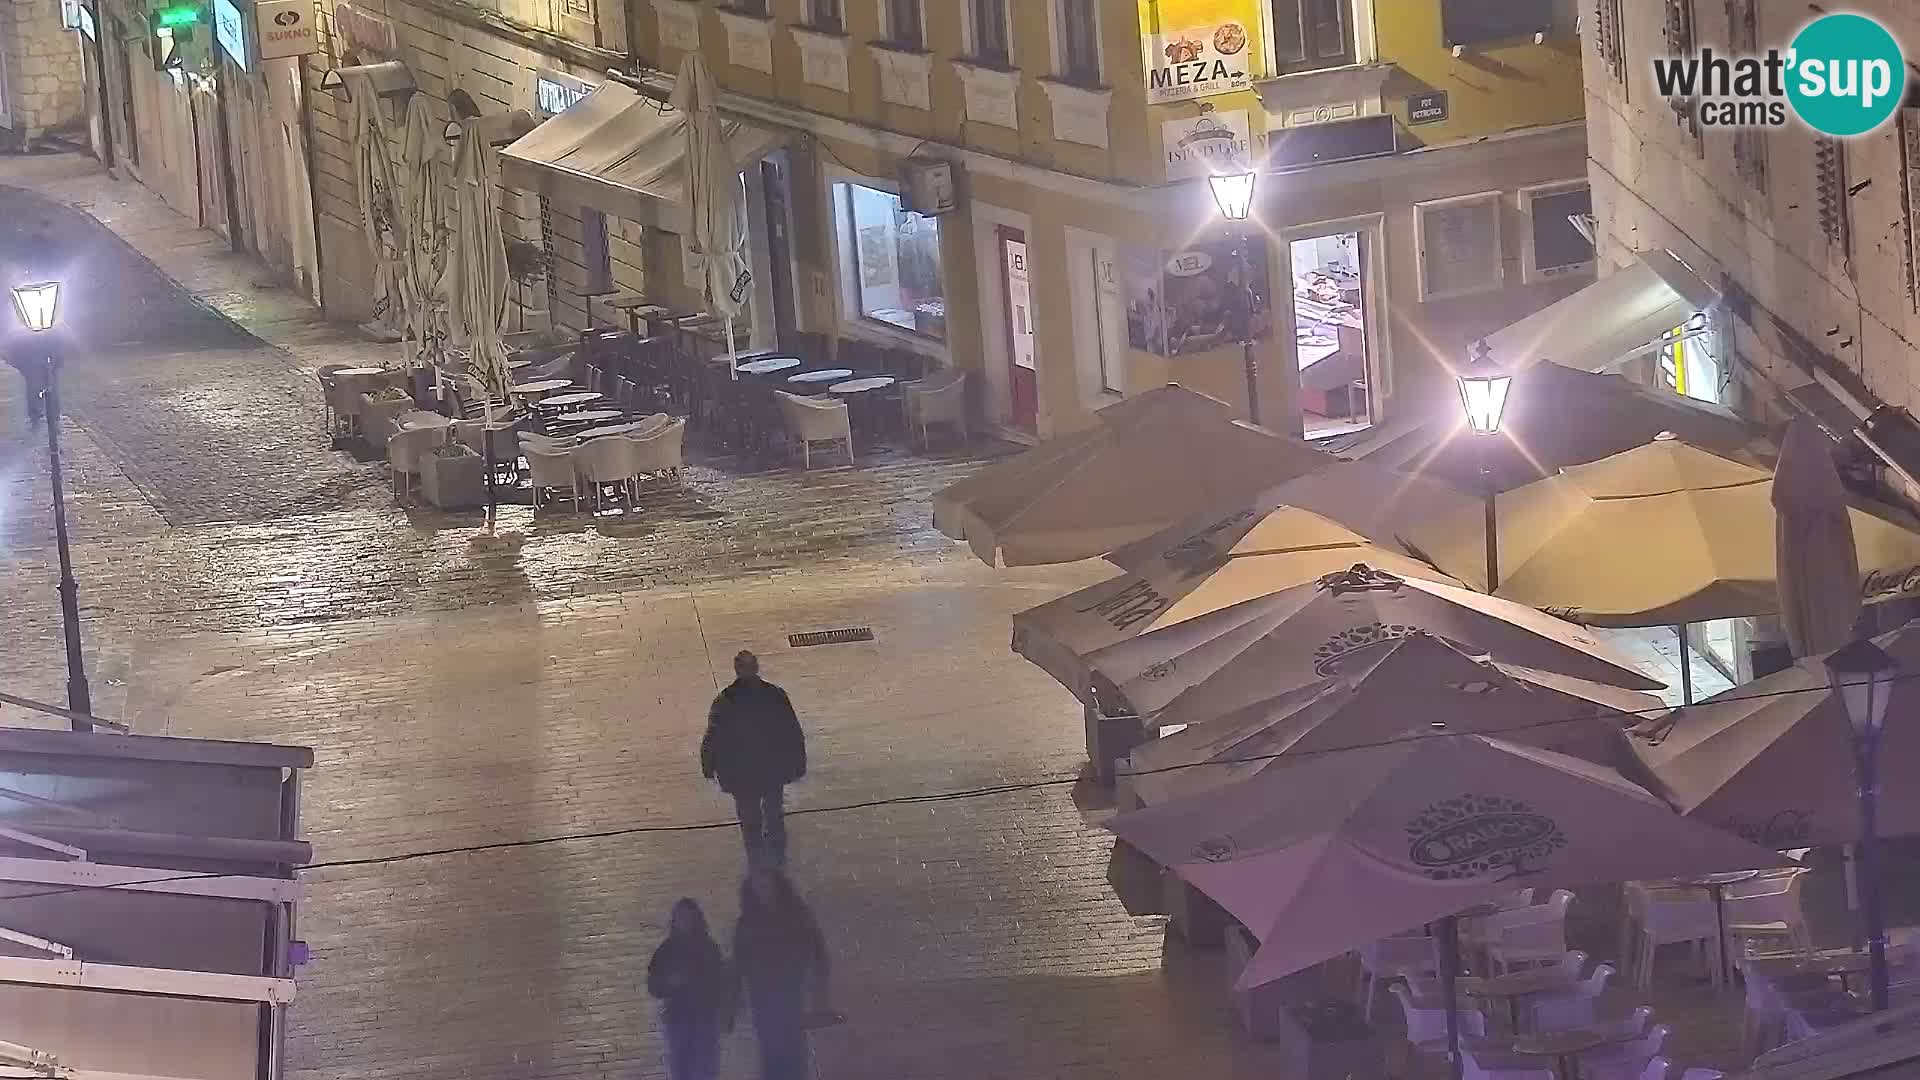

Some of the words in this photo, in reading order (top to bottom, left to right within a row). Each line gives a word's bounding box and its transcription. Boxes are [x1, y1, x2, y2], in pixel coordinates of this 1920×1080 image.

[265, 28, 311, 42] SUKNO
[1150, 59, 1229, 90] MEZA
[1159, 85, 1192, 97] PIZZERIA
[1200, 81, 1220, 92] GRILL
